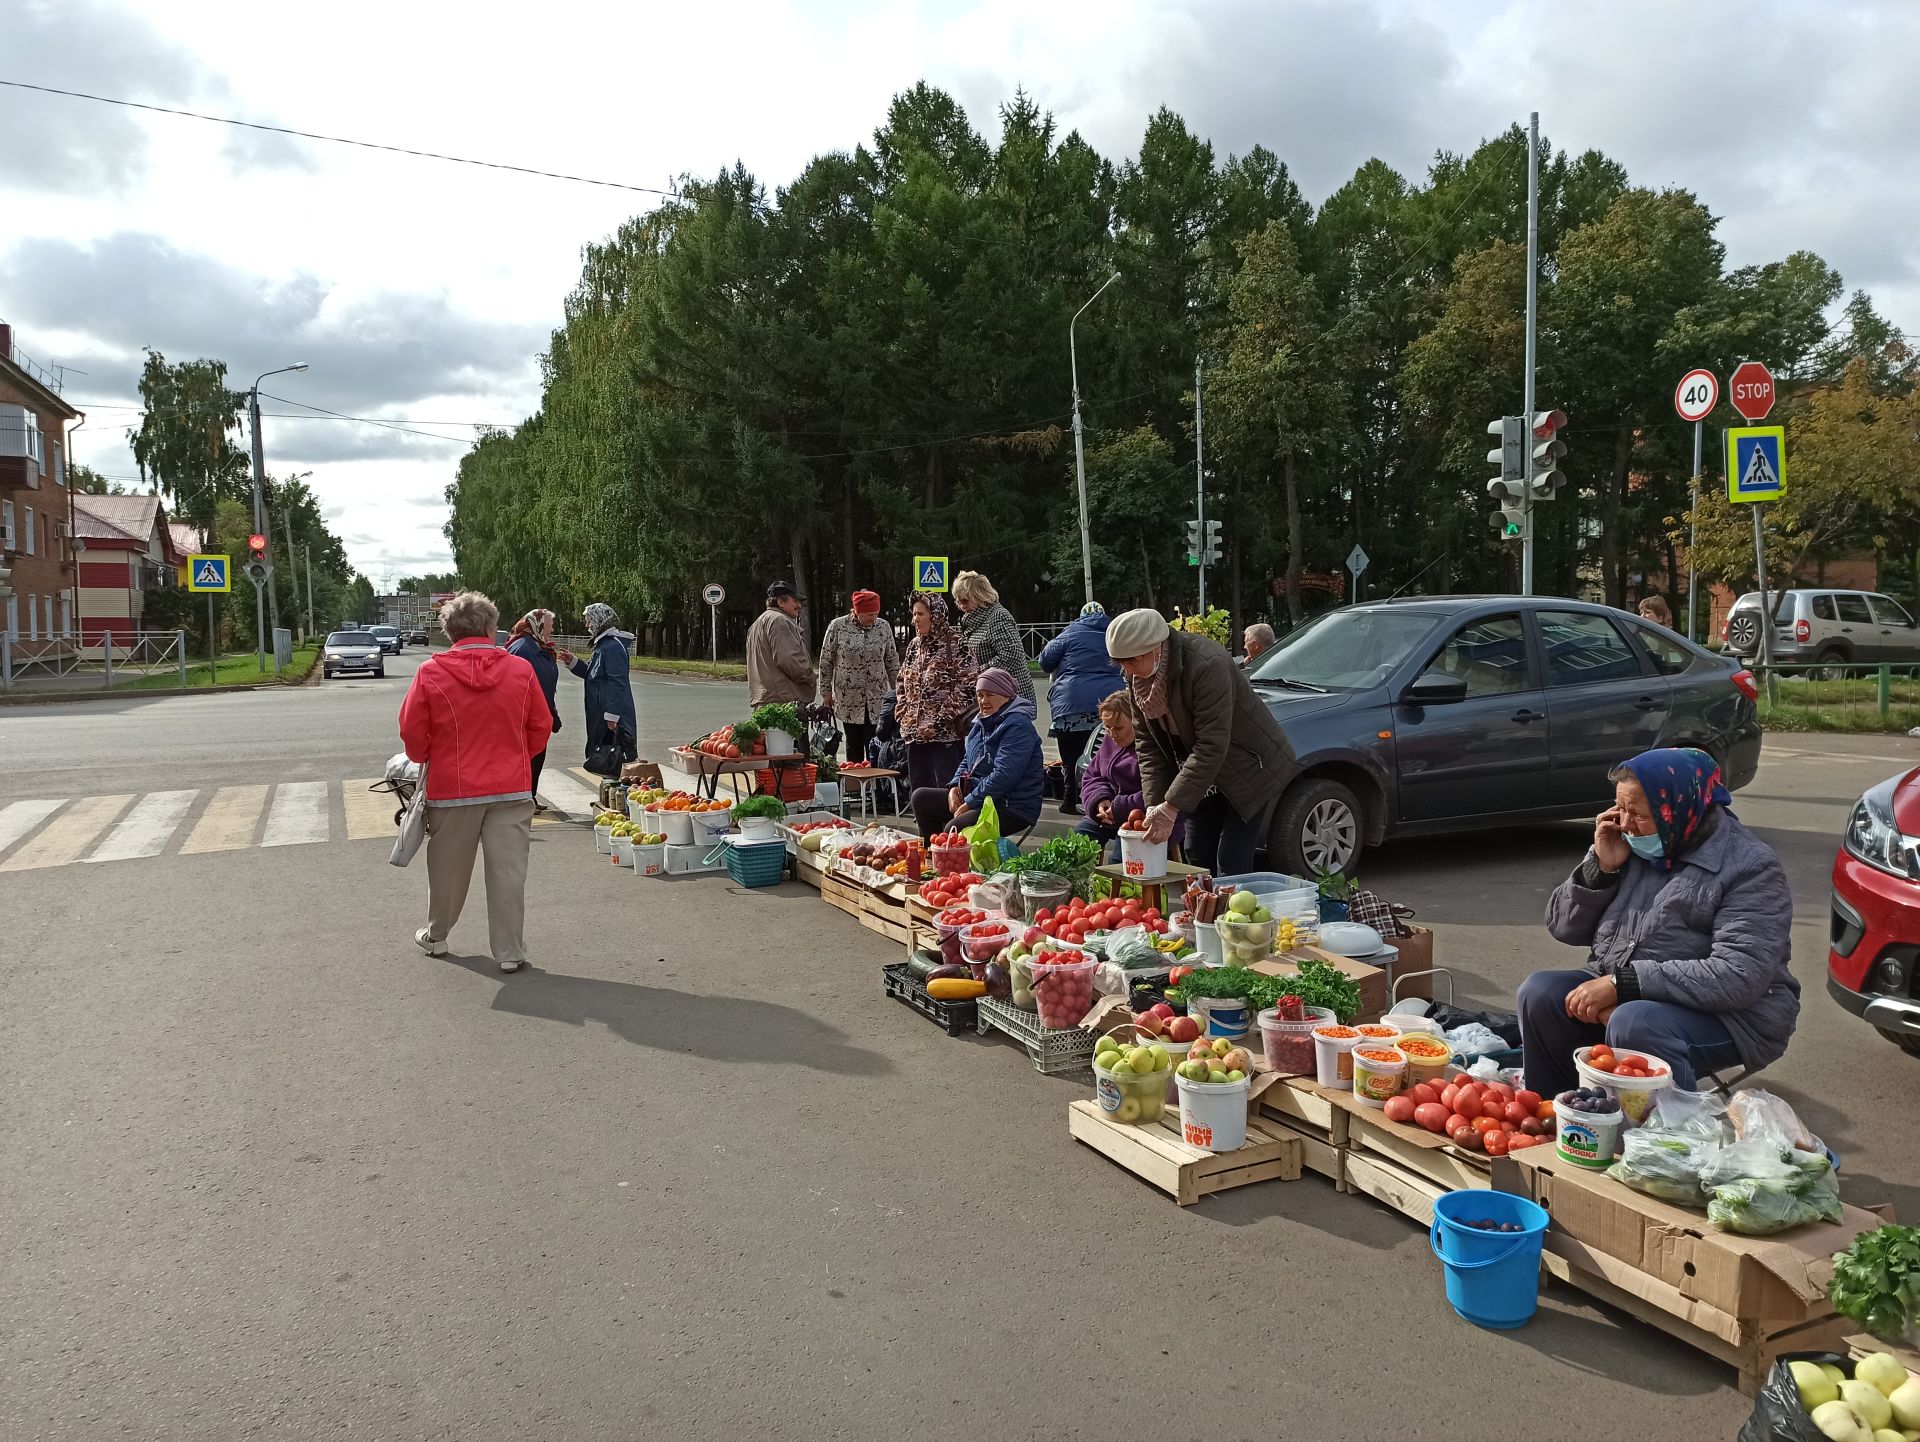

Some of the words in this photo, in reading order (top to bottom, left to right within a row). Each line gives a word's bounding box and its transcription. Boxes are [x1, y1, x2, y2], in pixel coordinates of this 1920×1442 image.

[1684, 384, 1708, 405] 40
[1737, 383, 1770, 399] STOP
[1186, 1131, 1213, 1148] КОТ
